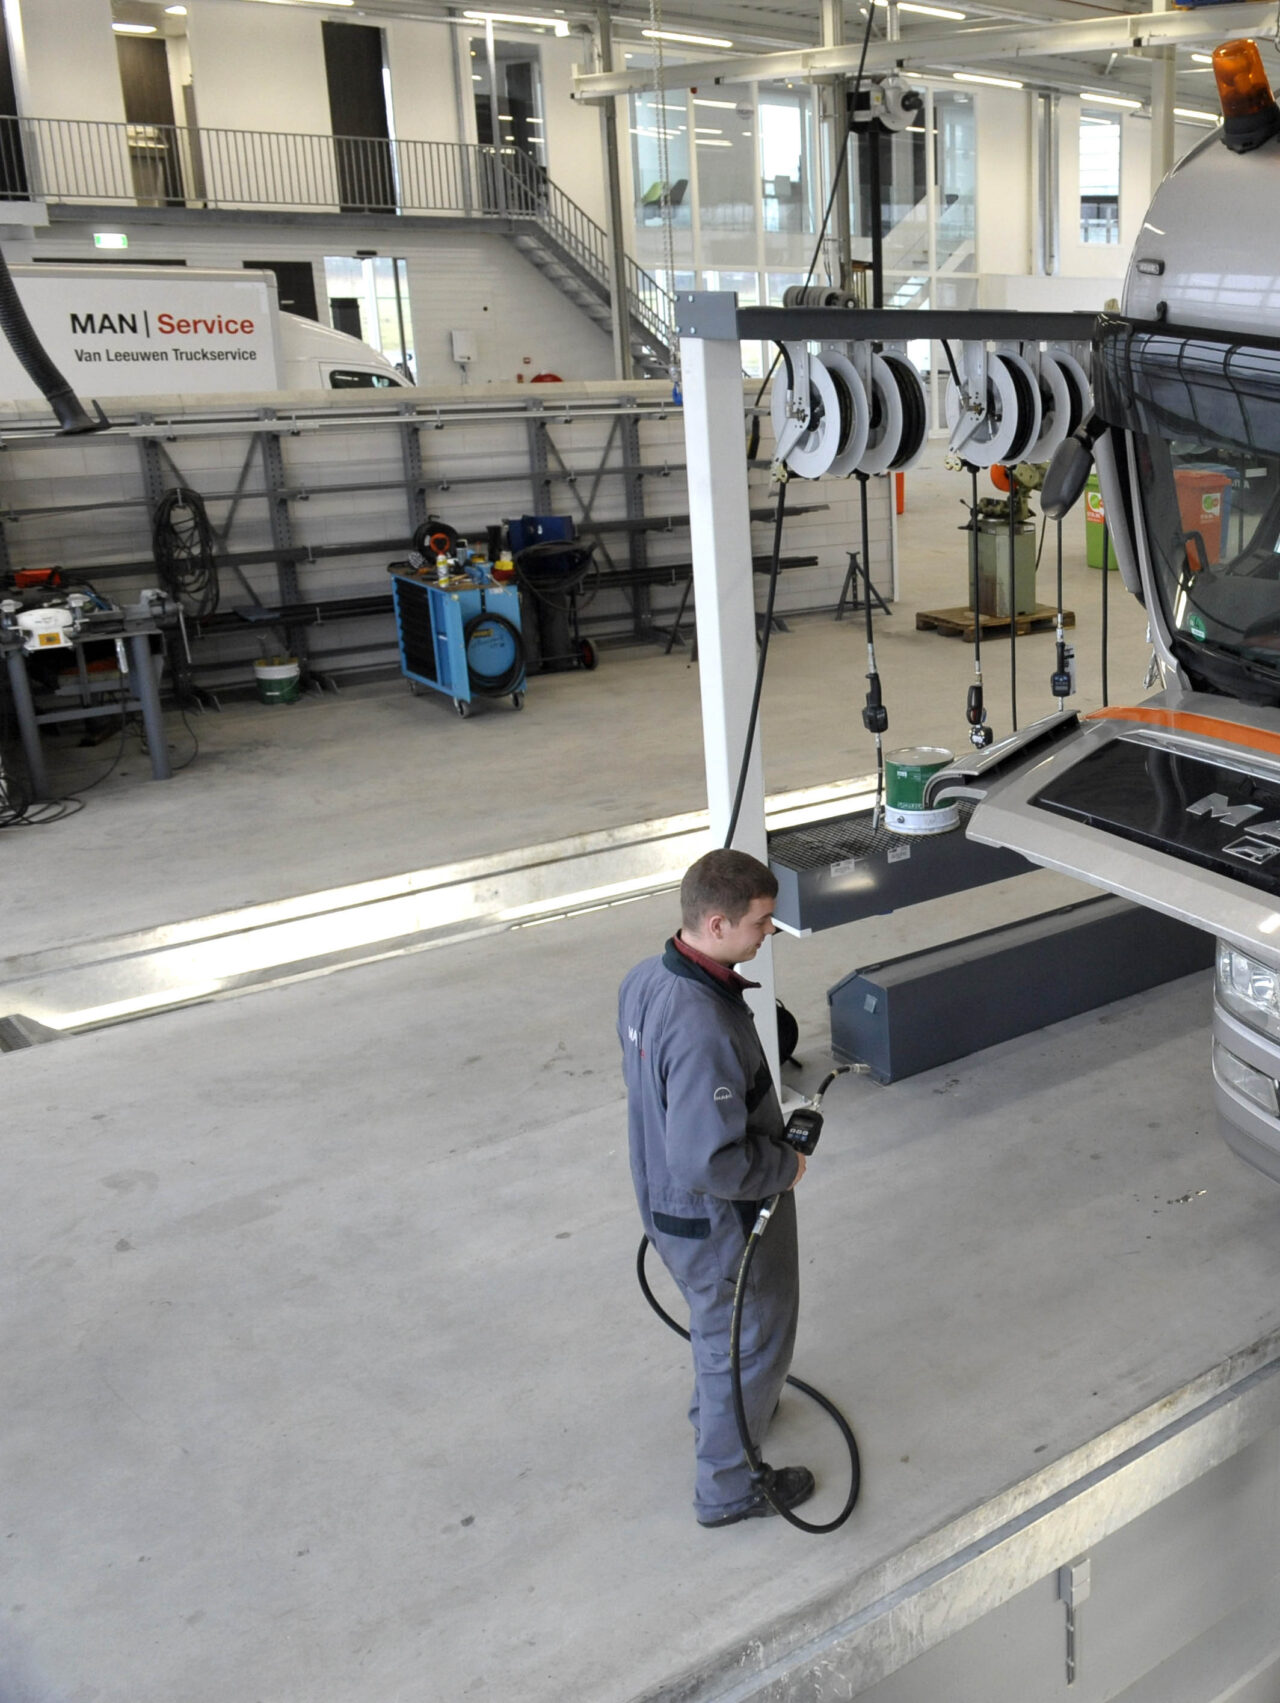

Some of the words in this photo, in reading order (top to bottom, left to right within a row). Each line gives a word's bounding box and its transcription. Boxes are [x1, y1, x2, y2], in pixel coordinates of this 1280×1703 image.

[70, 313, 138, 334] MAN
[157, 313, 255, 335] Service
[74, 349, 101, 362] Van
[106, 348, 169, 362] Leeuwen
[171, 348, 257, 362] Truckservice
